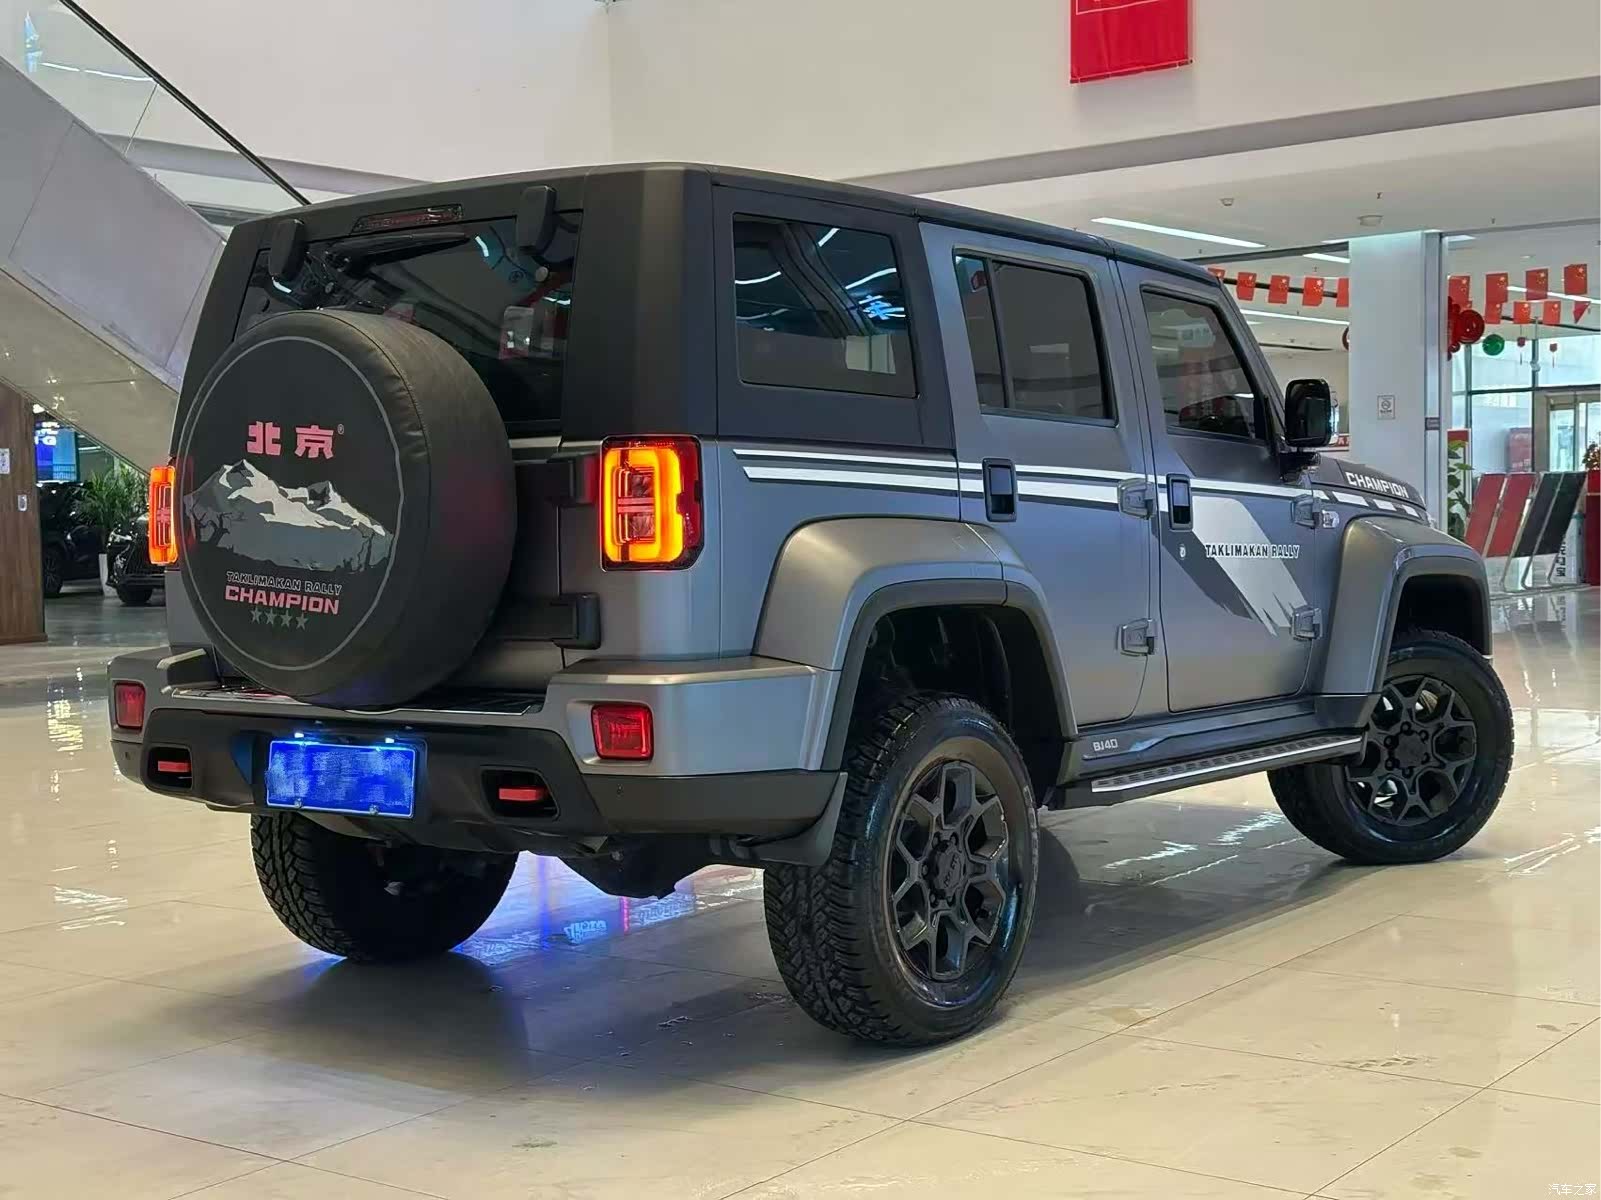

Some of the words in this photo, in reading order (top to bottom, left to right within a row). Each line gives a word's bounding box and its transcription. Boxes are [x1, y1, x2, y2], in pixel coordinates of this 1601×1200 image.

[247, 421, 334, 459] 北京
[1345, 471, 1409, 499] CHAMPION
[1205, 543, 1268, 557] TAKLIMAKAN
[1271, 544, 1300, 558] RALLY
[226, 571, 302, 592] TAKLIMAKAN
[304, 580, 342, 596] RALLY
[225, 585, 340, 615] CHAMPION
[1093, 738, 1118, 752] BJ40
